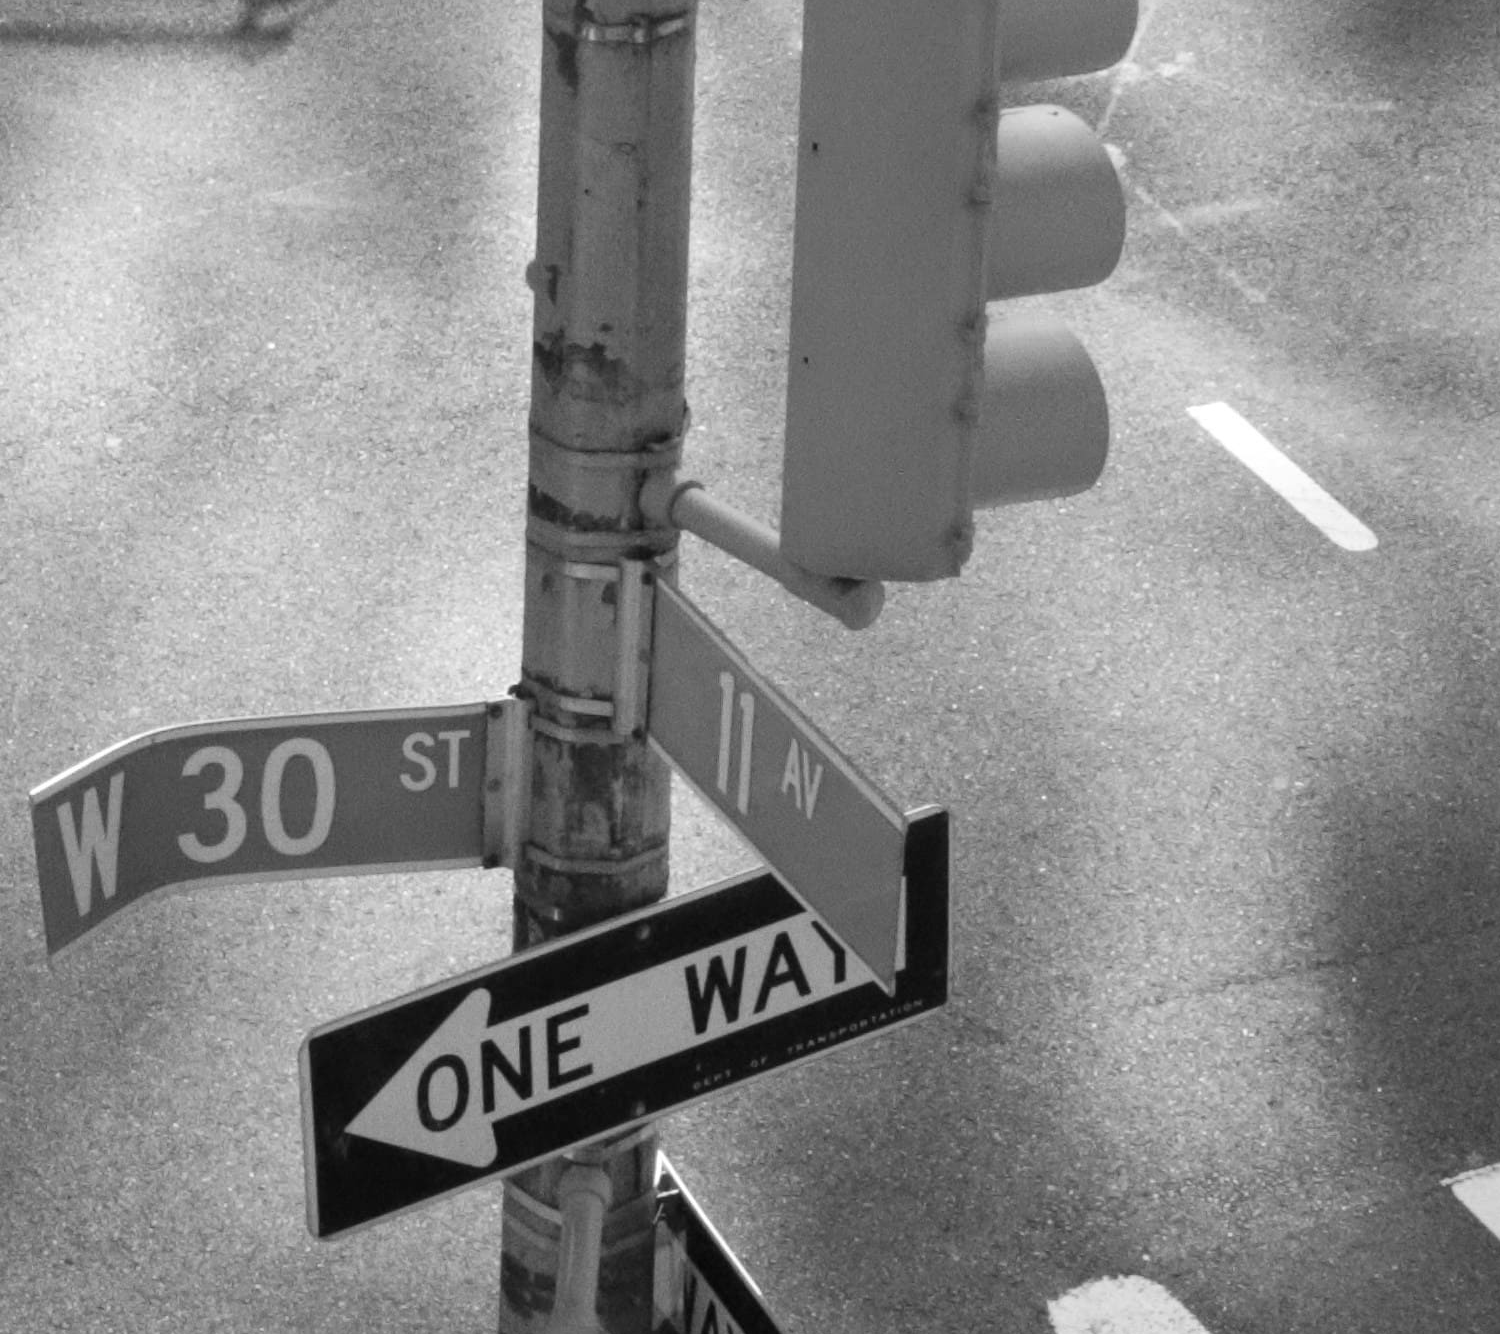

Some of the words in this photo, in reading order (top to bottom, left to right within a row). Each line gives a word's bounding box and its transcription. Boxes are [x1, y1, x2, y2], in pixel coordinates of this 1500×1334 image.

[717, 672, 755, 816] 11
[781, 738, 823, 820] AV
[57, 771, 125, 917] W
[177, 737, 336, 863] 30
[400, 729, 471, 792] ST
[416, 1003, 594, 1133] ONE
[786, 998, 924, 1055] TRANSPORTATION
